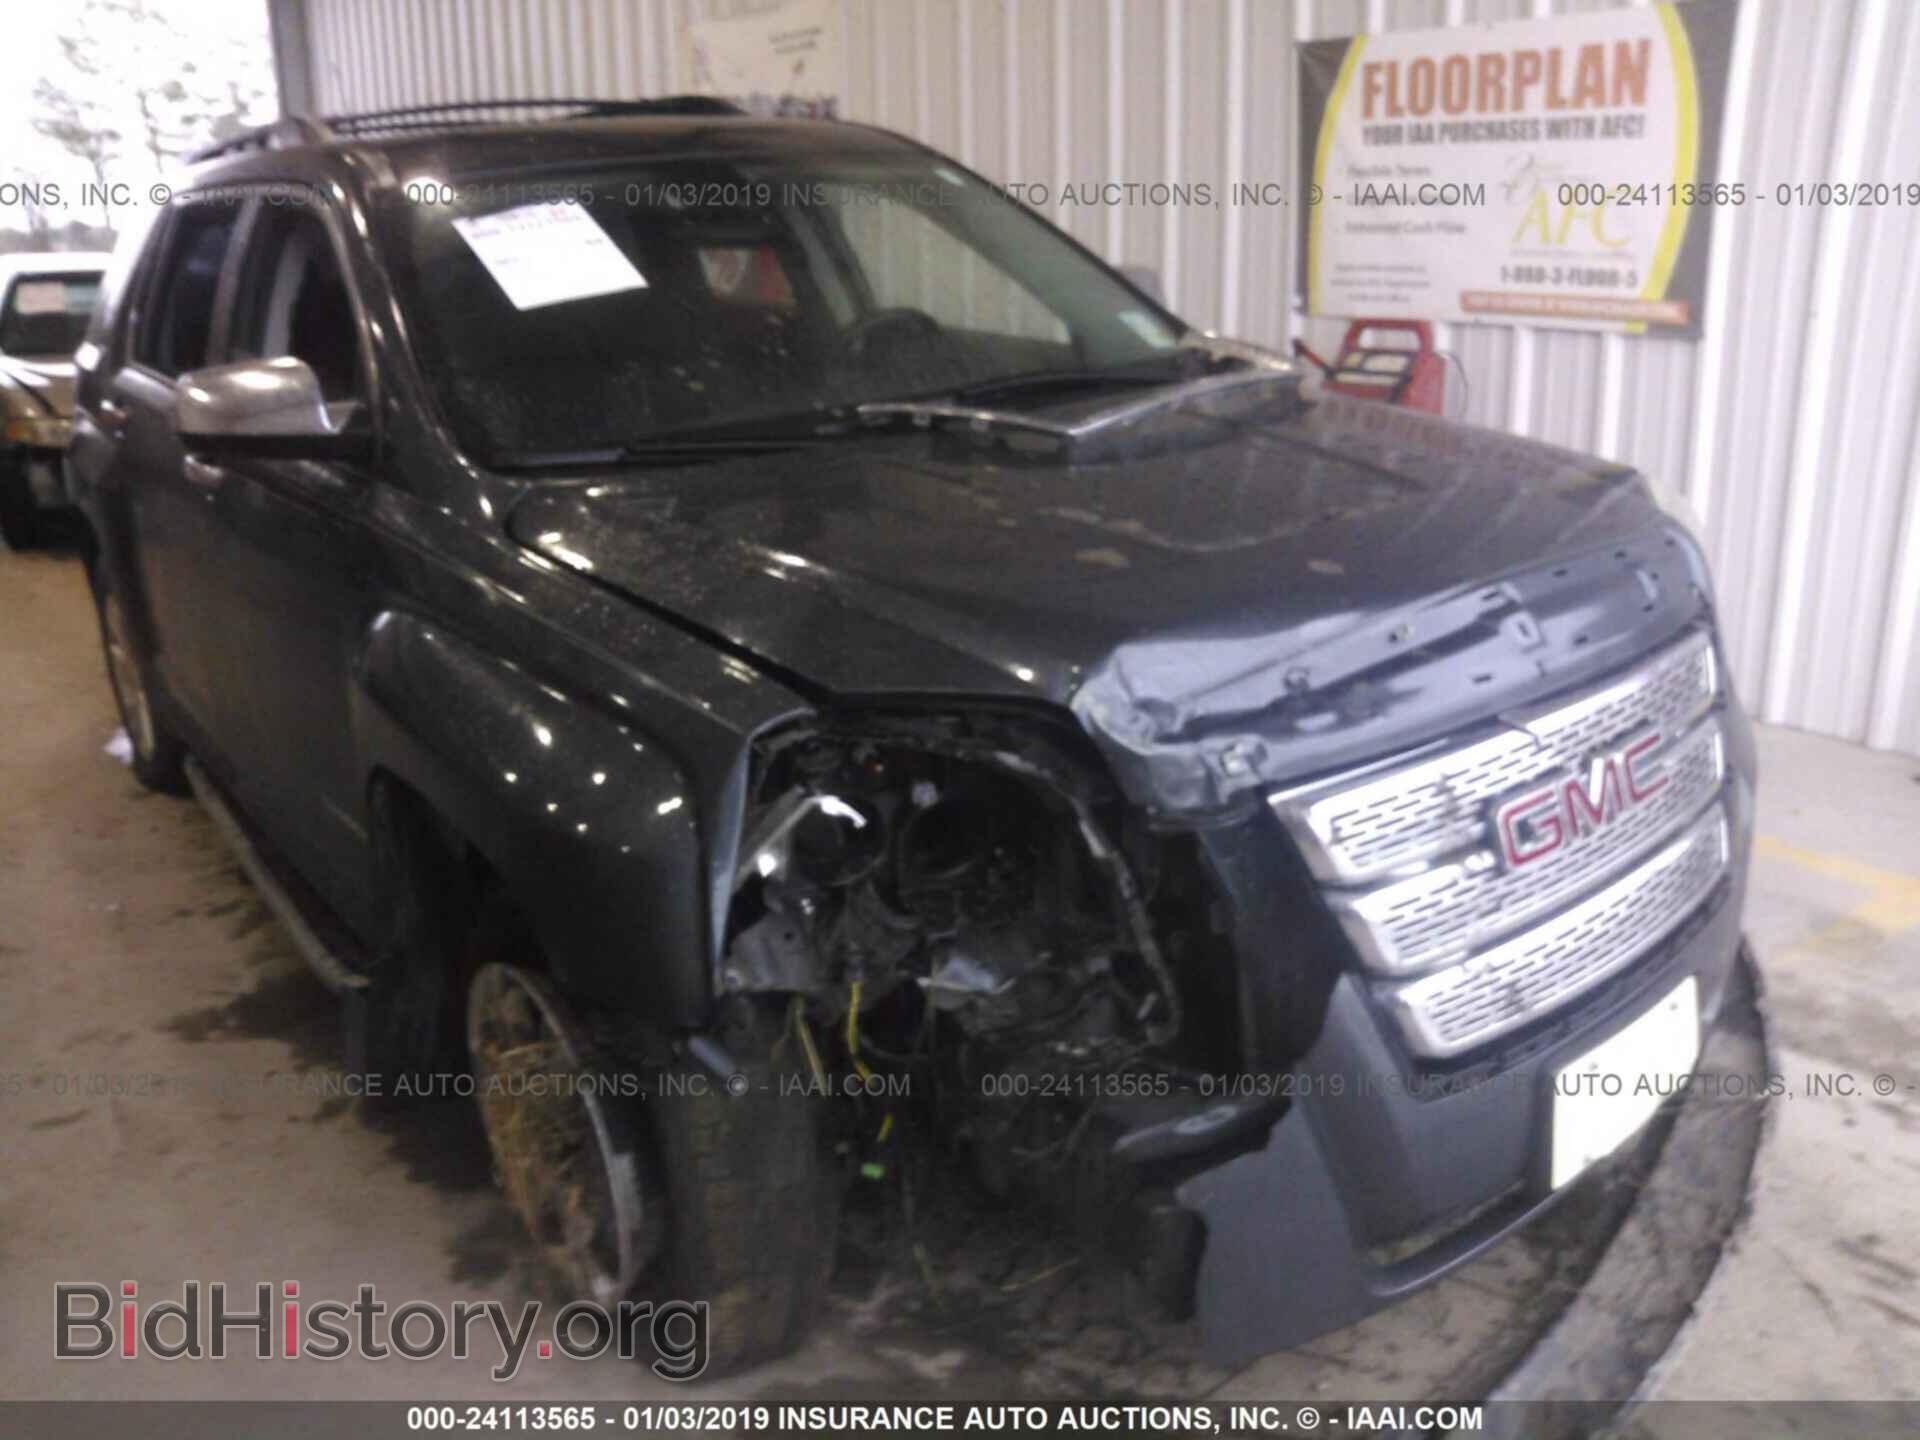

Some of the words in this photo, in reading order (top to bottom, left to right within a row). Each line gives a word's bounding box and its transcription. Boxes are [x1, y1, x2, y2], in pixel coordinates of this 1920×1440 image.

[1362, 38, 1652, 119] FLOORPLAN
[1438, 117, 1541, 143] PURCHASES
[1545, 115, 1596, 140] WITH
[1599, 114, 1646, 139] AFC!
[1498, 732, 1671, 868] GMC
